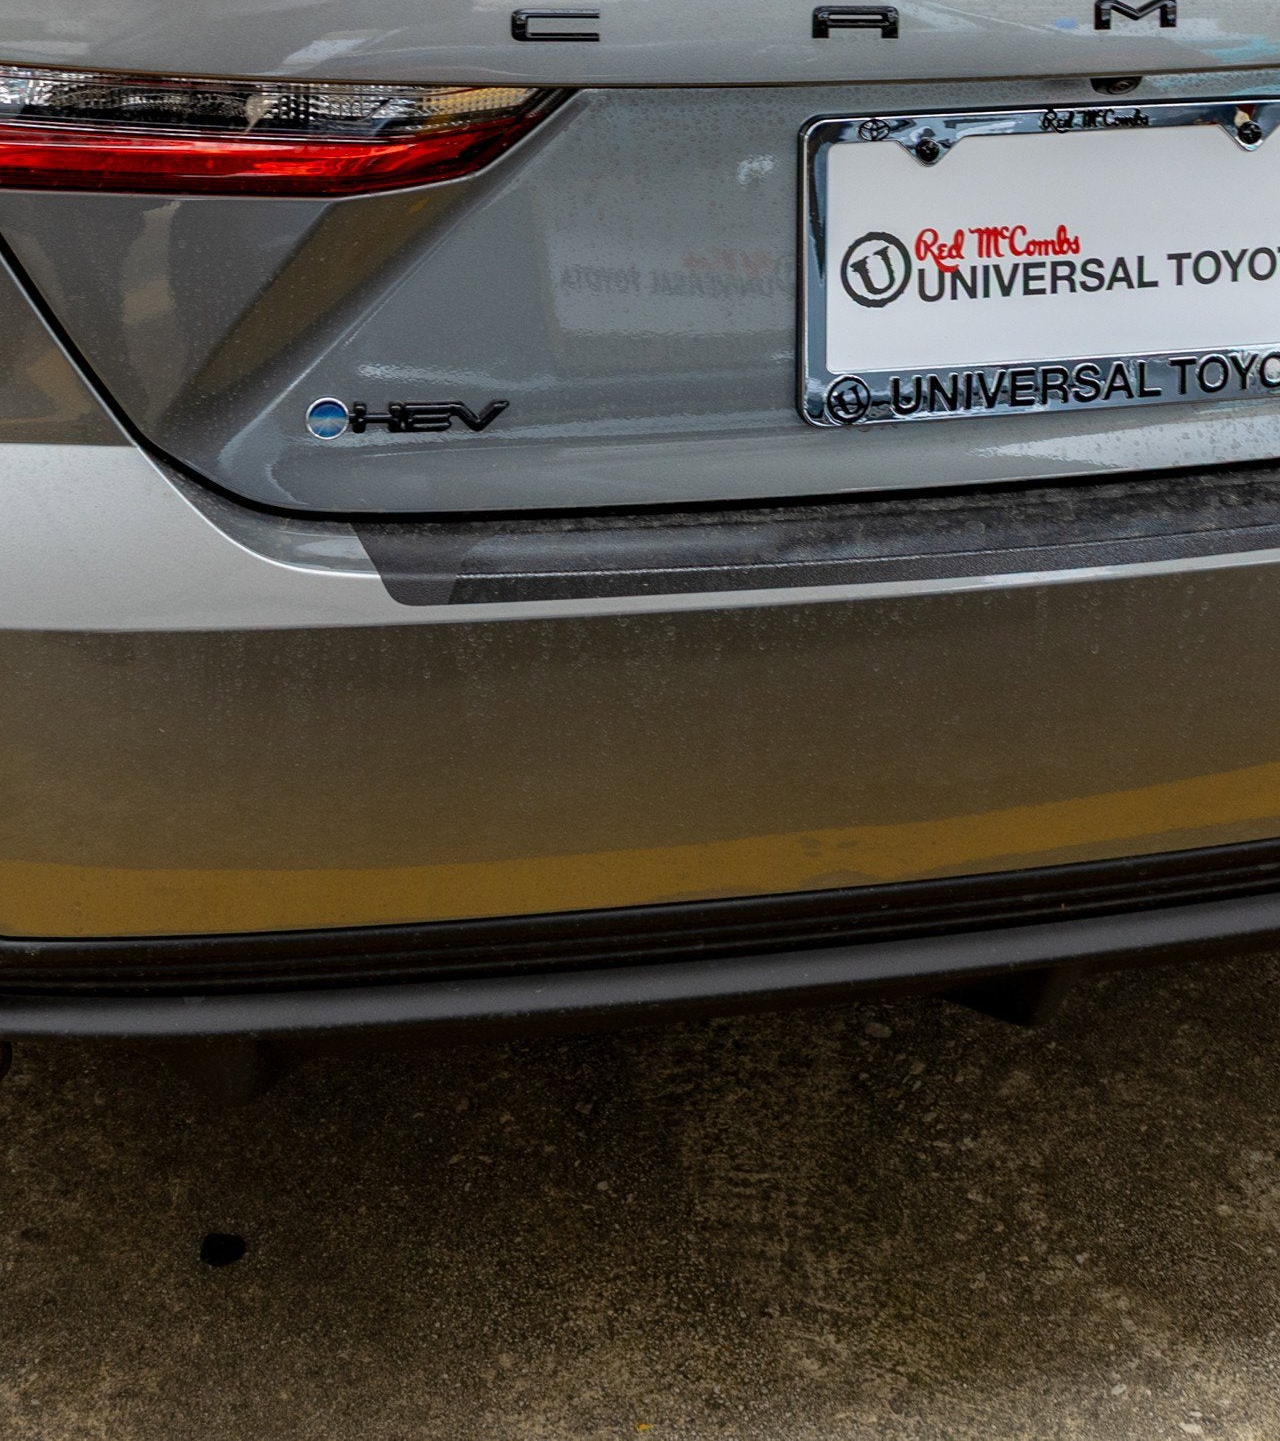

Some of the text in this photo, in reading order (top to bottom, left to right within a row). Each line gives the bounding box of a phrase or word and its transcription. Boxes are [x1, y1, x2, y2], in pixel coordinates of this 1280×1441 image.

[1039, 108, 1075, 134] Red
[914, 224, 1081, 274] Red McCombs
[917, 255, 1159, 302] UNIVERSAL
[889, 360, 1163, 415] UNIVERSAL
[350, 399, 510, 434] HEV
